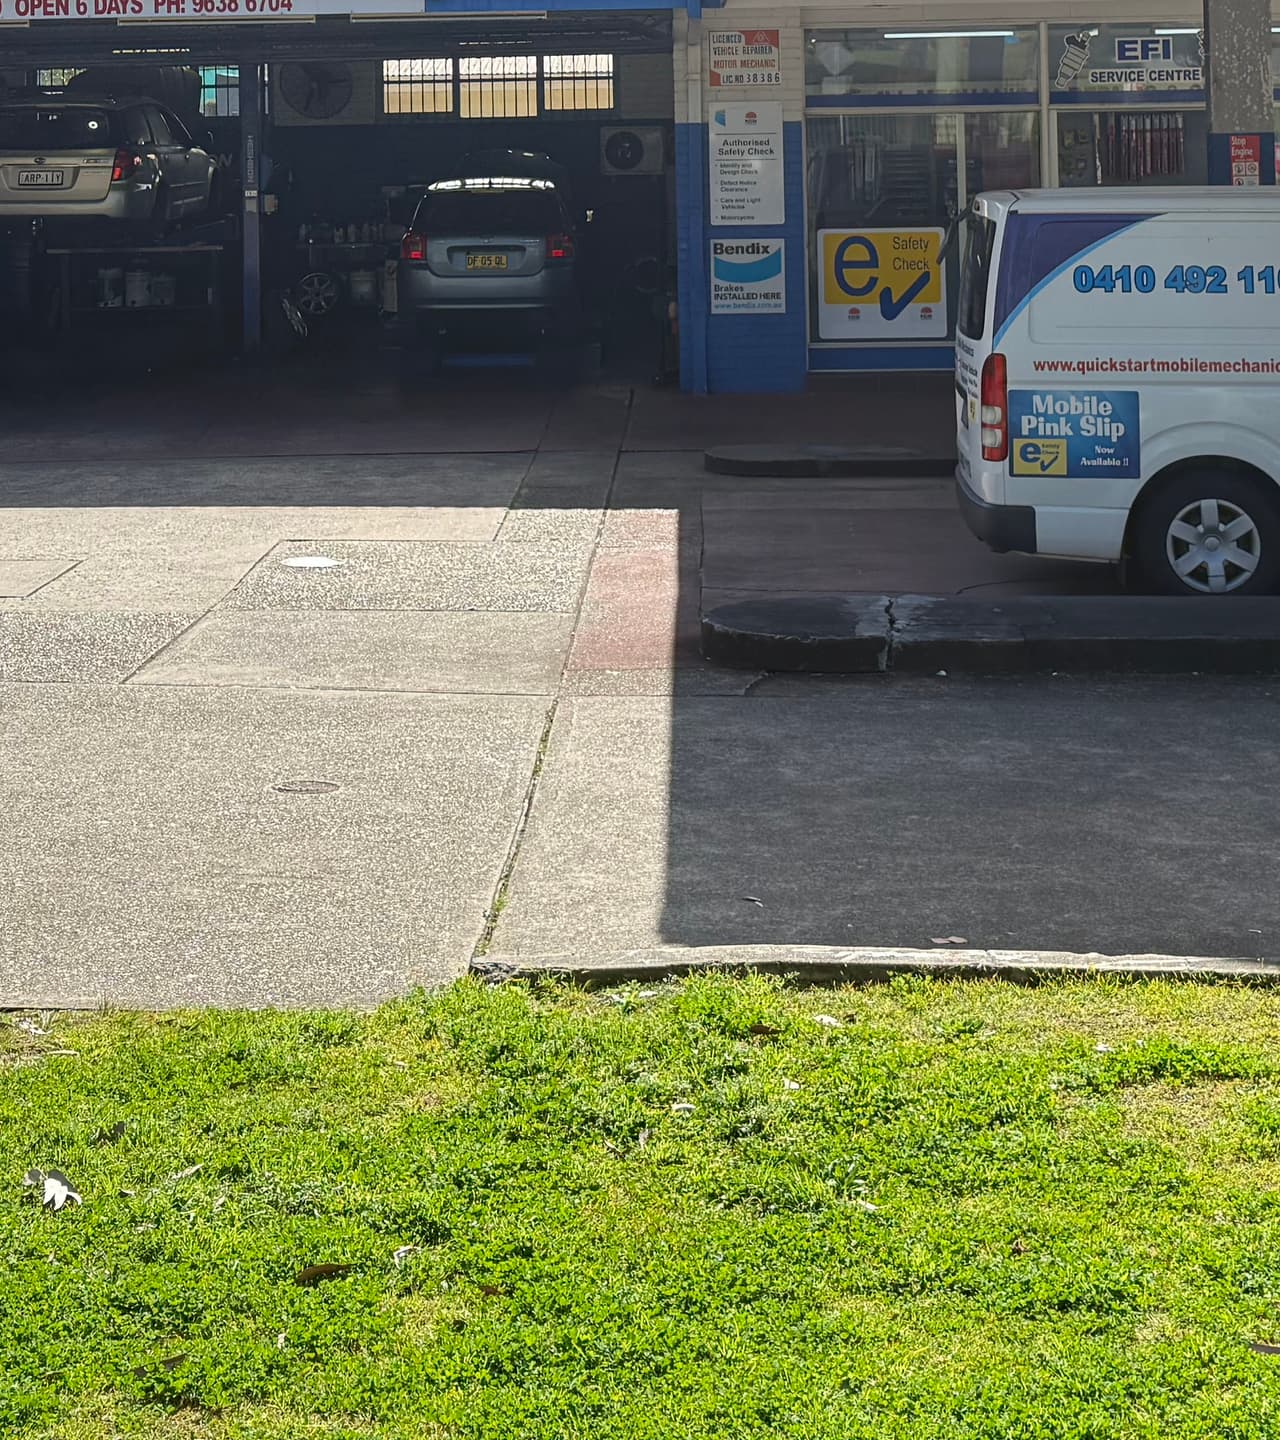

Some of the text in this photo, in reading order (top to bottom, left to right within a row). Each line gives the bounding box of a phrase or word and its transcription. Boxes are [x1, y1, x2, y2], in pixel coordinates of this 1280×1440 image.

[712, 45, 773, 56] VEHICLE REPAIRER
[1118, 40, 1171, 60] EFI
[713, 59, 775, 69] MOTOR MECHANIC
[746, 73, 780, 83] 38386
[1090, 69, 1201, 84] SERVICE CENTRE
[723, 138, 770, 147] Authorised
[1232, 136, 1246, 147] Stop
[718, 147, 775, 157] Safety Check
[1232, 147, 1253, 158] Engine
[713, 243, 770, 255] Bendix
[893, 236, 929, 252] Safety
[893, 257, 930, 270] Check
[1073, 265, 1156, 293] 0410
[1164, 265, 1228, 294] 492
[714, 284, 744, 292] Brakes
[714, 292, 781, 301] INSTALLED HERE
[1033, 395, 1112, 415] Mobile
[1021, 415, 1125, 442] Pink Slip
[1095, 445, 1115, 454] Now
[1080, 457, 1121, 466] Available
